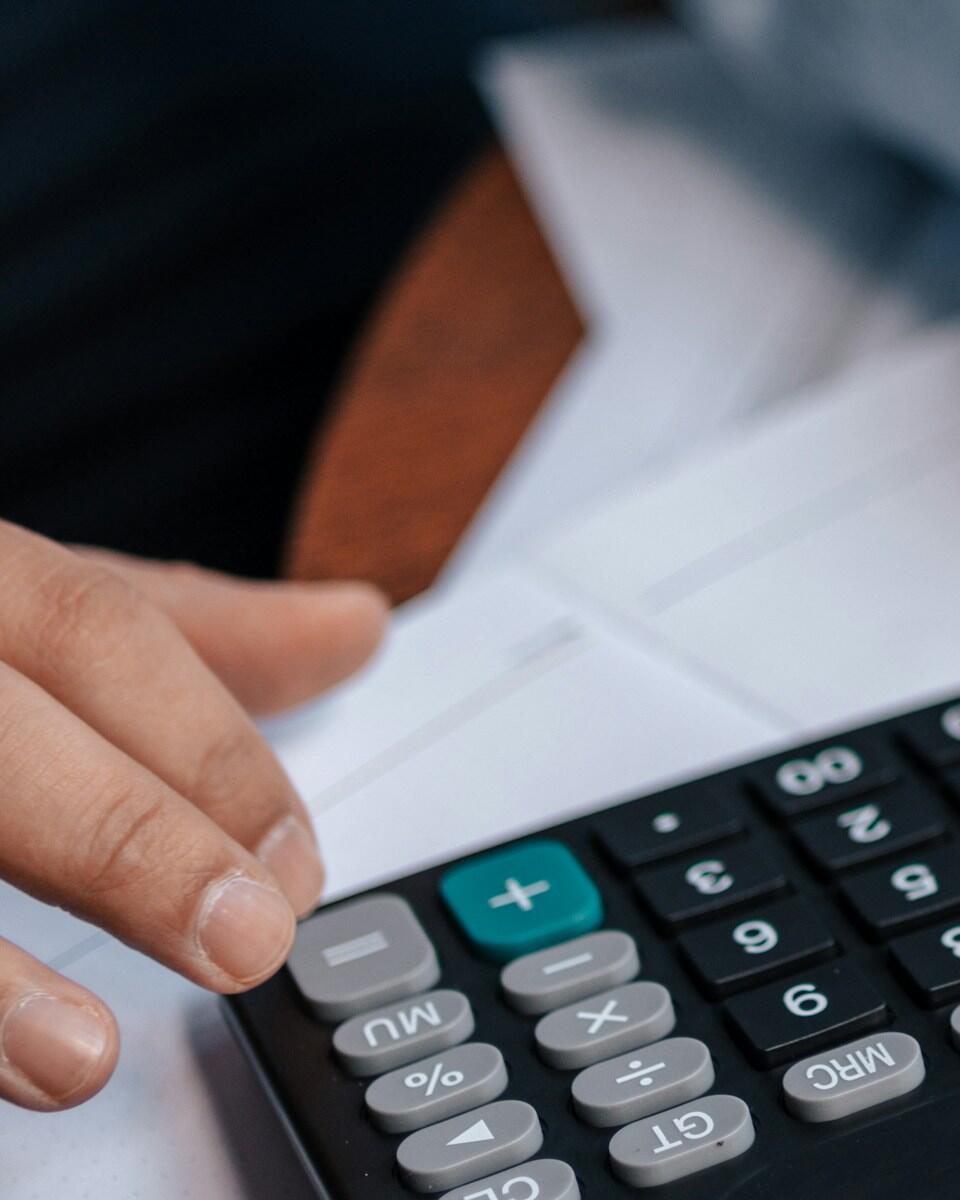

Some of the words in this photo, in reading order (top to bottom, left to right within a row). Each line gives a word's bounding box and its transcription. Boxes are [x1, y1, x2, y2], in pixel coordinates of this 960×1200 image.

[774, 746, 863, 796] 00
[838, 805, 891, 843] 2
[489, 878, 550, 911] +
[686, 860, 733, 894] 3
[891, 864, 938, 901] 5
[733, 920, 778, 954] 6
[783, 983, 828, 1017] 9
[363, 1001, 442, 1047] MU
[404, 1062, 466, 1097] %
[806, 1043, 896, 1092] MRC
[651, 1111, 715, 1154] GT
